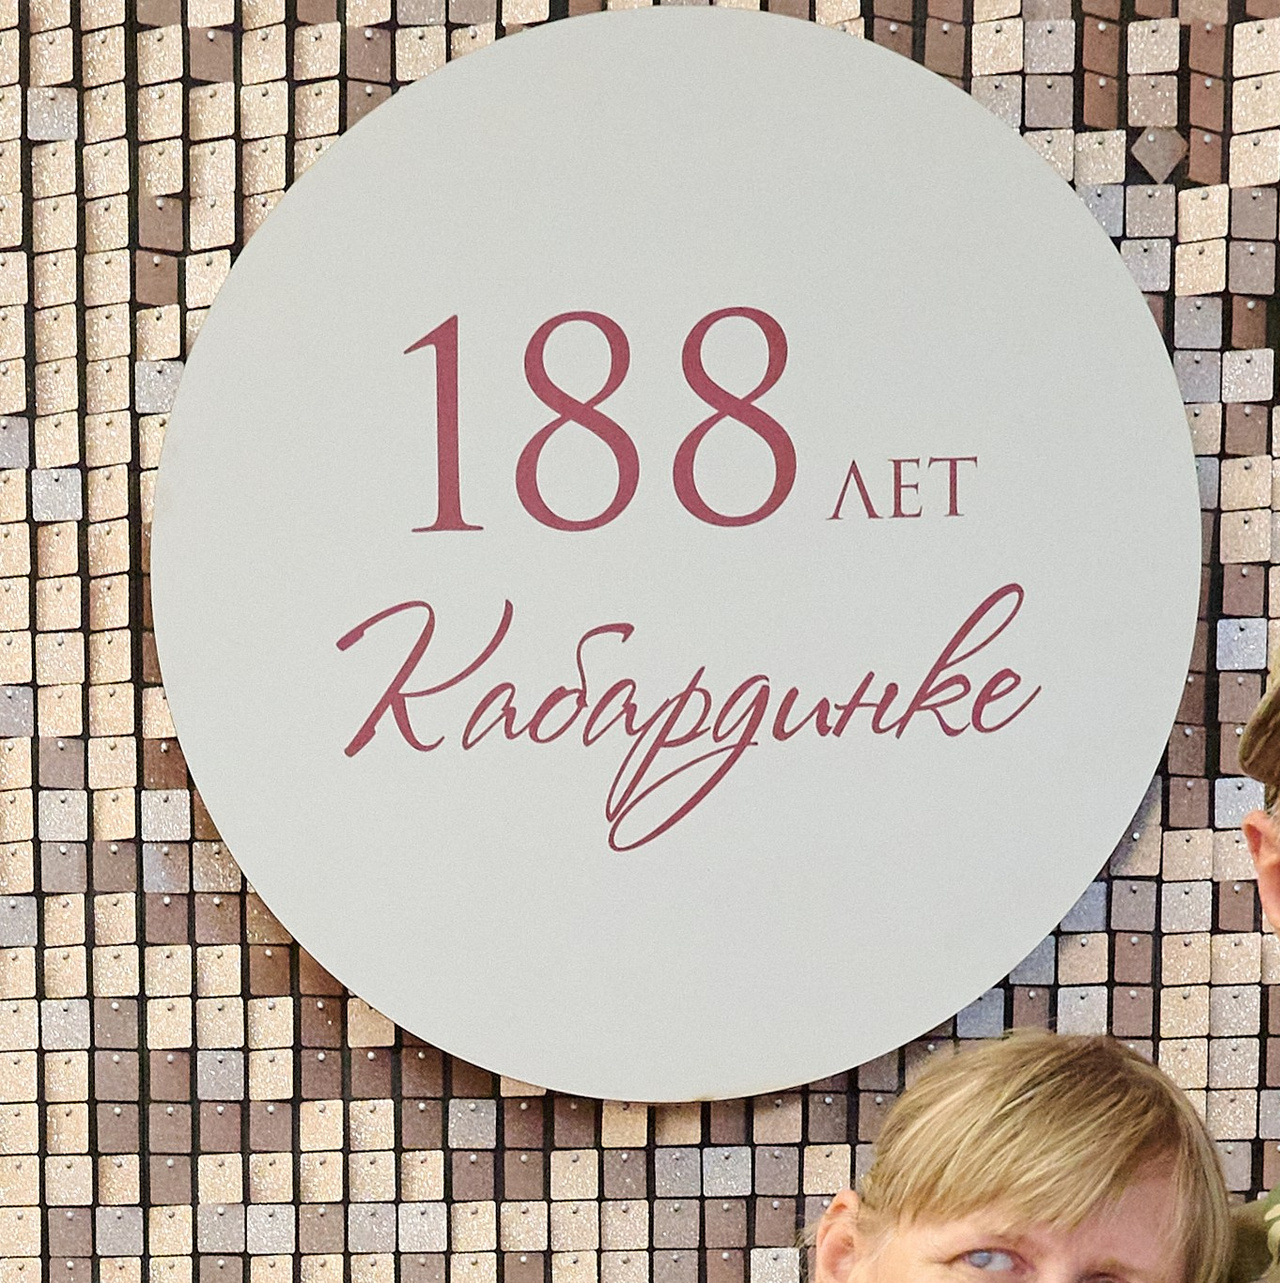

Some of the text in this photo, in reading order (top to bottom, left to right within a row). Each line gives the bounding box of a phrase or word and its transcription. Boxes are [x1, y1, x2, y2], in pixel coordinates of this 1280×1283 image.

[403, 306, 978, 533] 188 ЛЕТ
[336, 583, 1041, 852] Кабардинке
